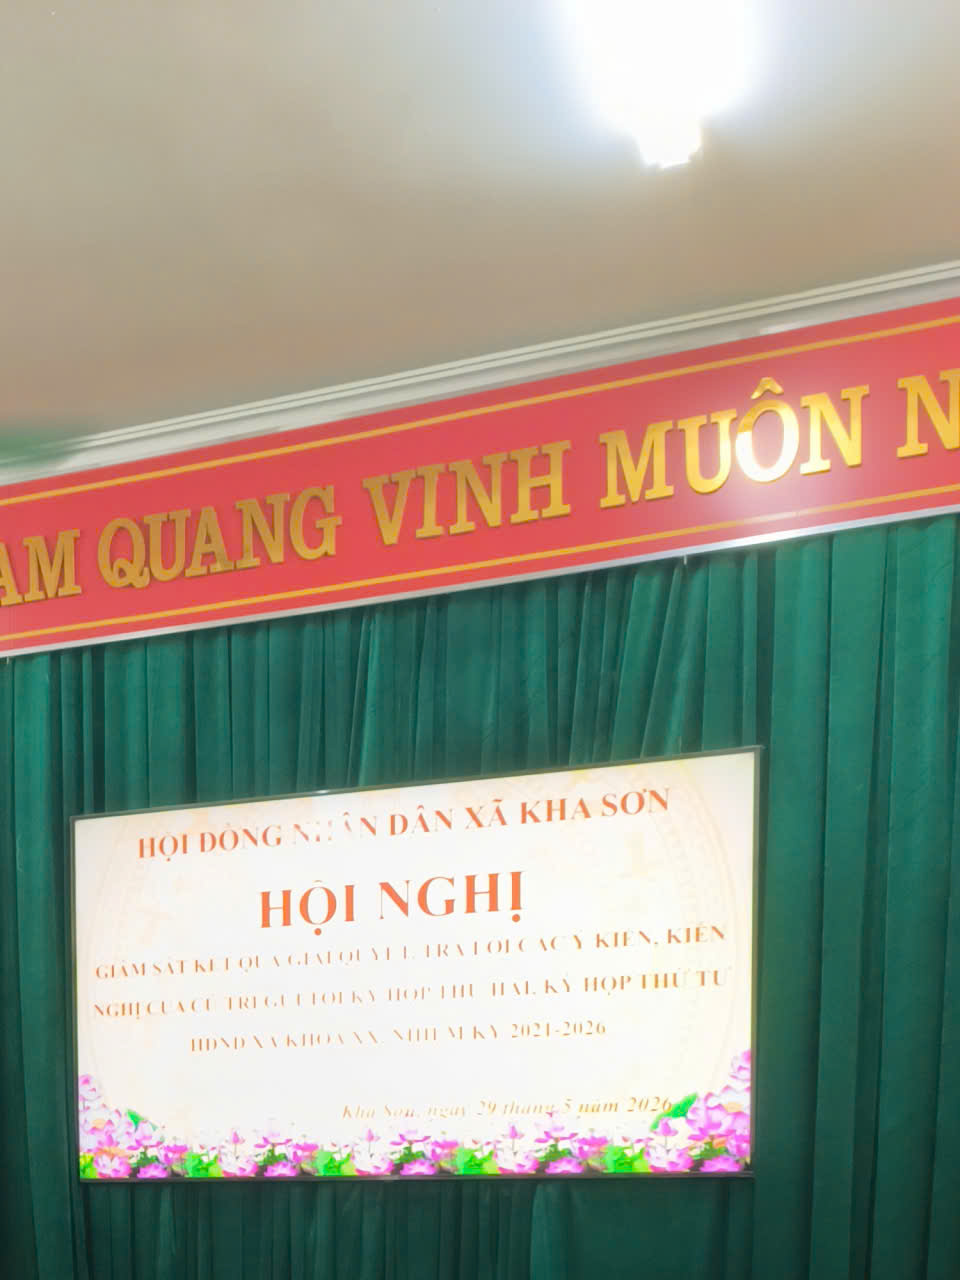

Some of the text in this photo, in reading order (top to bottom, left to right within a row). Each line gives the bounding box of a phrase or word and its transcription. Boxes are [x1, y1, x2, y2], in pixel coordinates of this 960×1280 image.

[96, 484, 343, 590] QUANG
[362, 439, 572, 547] VINH
[599, 376, 871, 511] MUÔN
[390, 804, 453, 837] DÂN
[465, 798, 508, 830] XÃ
[520, 797, 592, 825] KHA
[601, 788, 670, 818] SƠN
[260, 870, 526, 936] HỘI NGHỊ
